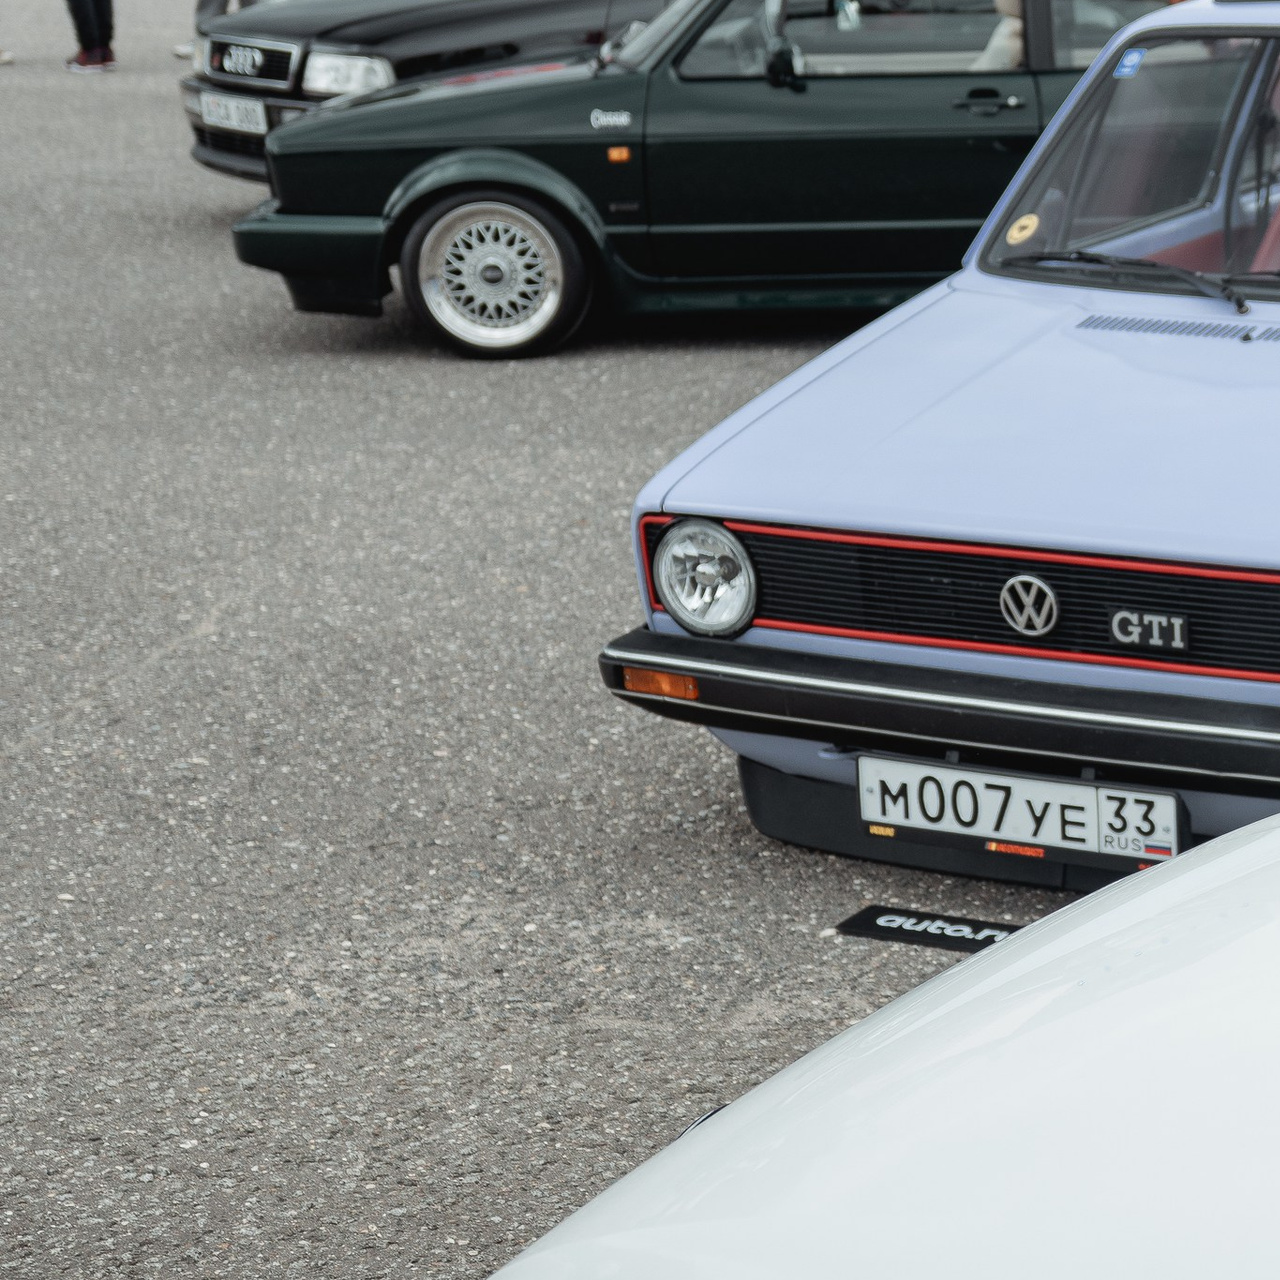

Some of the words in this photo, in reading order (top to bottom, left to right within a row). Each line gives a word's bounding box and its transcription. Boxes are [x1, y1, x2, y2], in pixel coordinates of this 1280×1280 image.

[1111, 610, 1185, 649] GTI
[1106, 795, 1156, 837] 33
[1104, 834, 1142, 852] RUS
